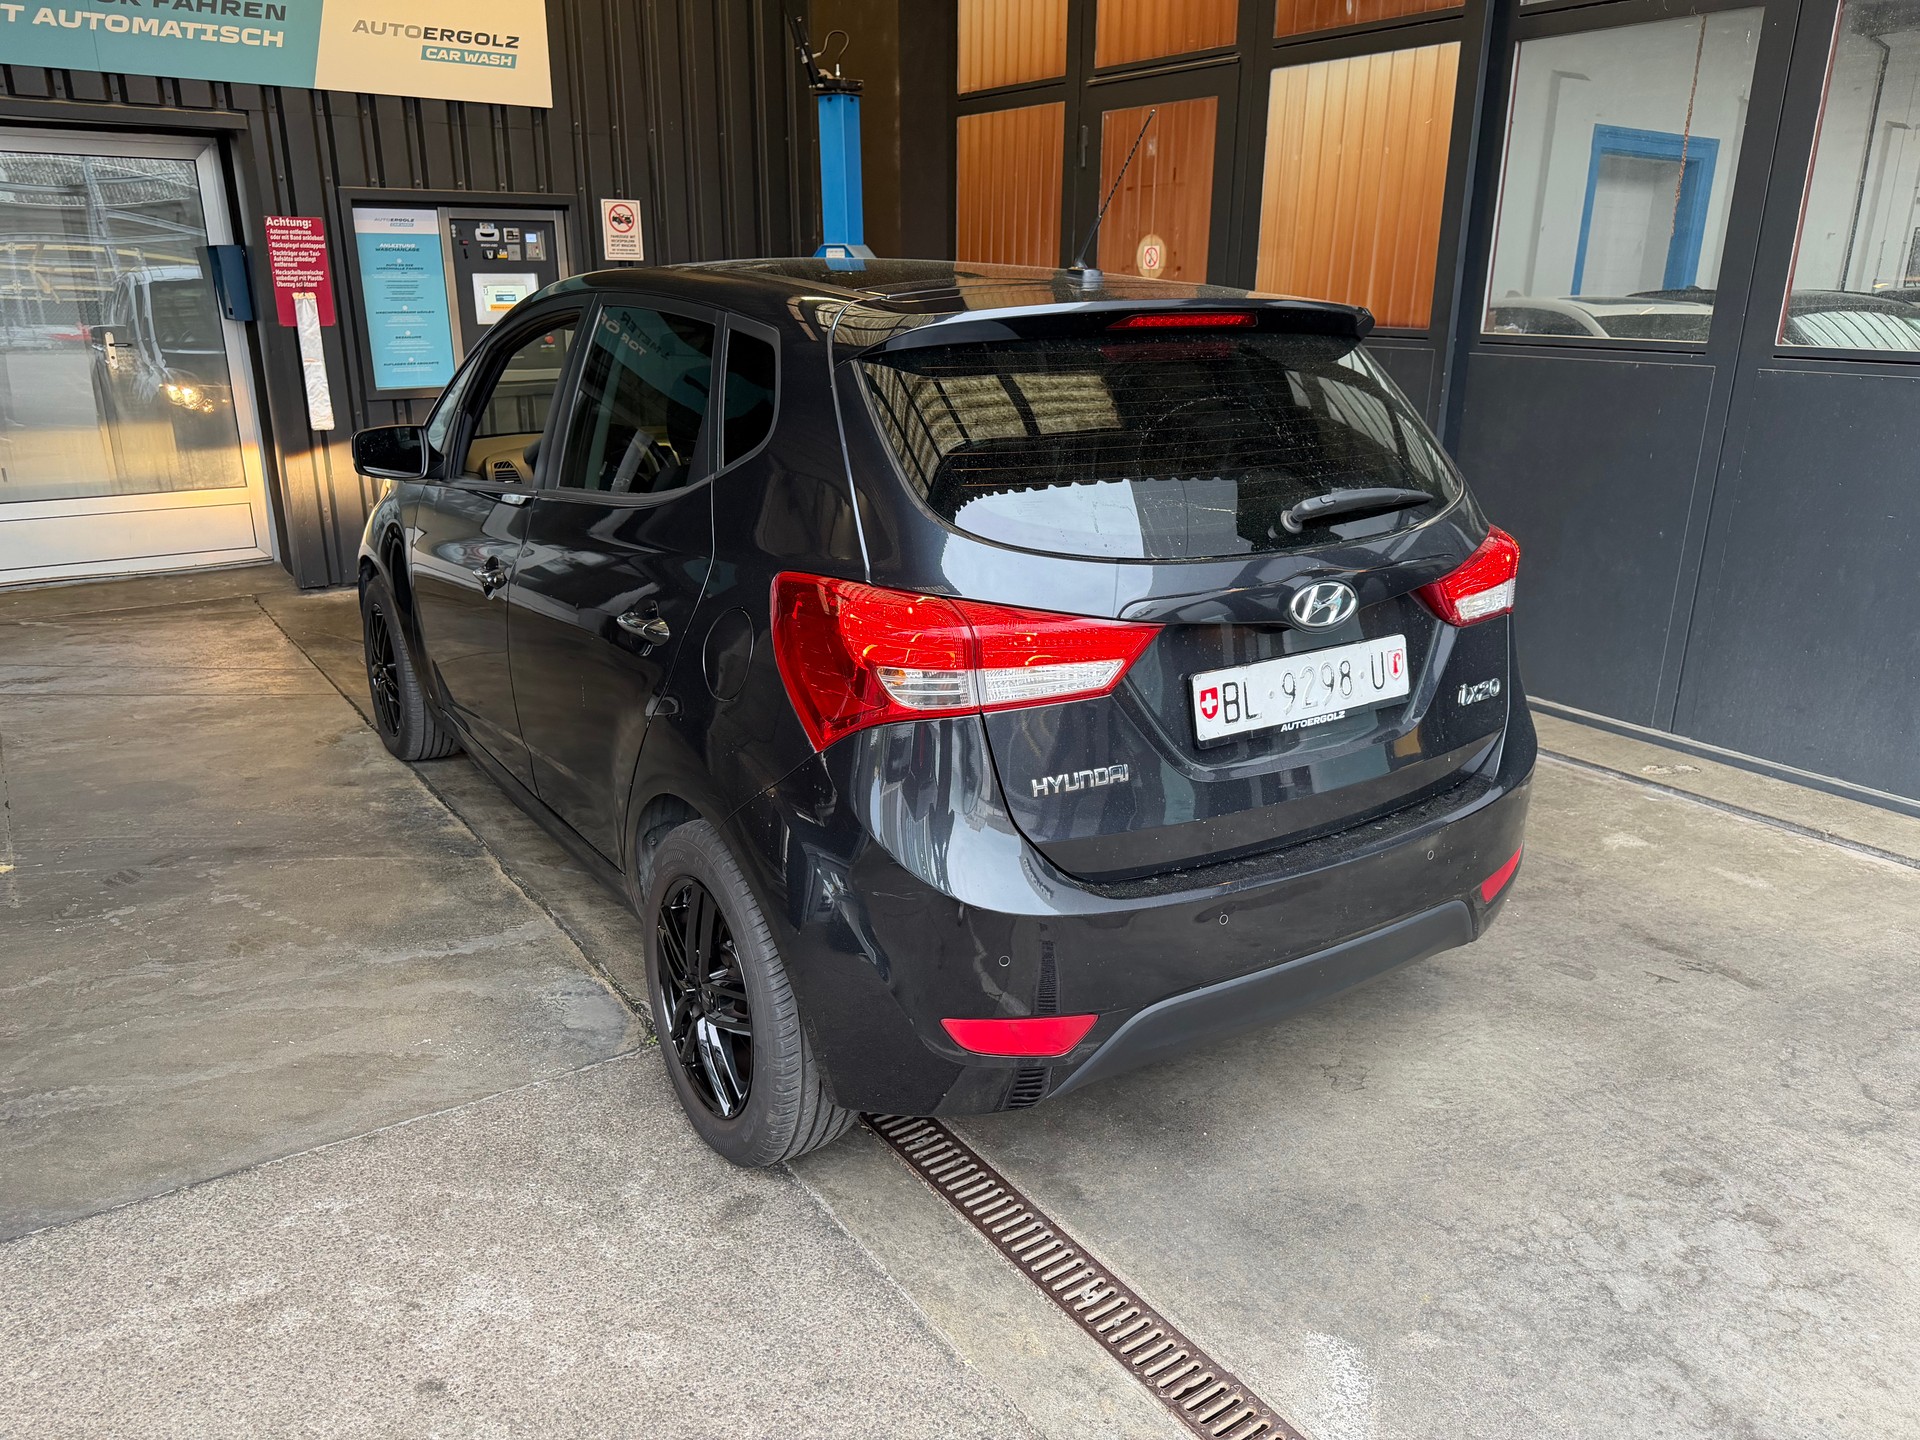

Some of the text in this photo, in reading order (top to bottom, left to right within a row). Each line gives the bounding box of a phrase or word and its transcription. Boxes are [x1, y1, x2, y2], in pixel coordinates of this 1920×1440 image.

[32, 7, 284, 47] AUTOMATISCH
[352, 19, 519, 49] AUTOERGOLZ
[425, 48, 512, 66] CAR WASH
[266, 217, 312, 229] Achtung:
[1222, 651, 1386, 724] BL 9298 U
[1280, 710, 1346, 732] AUTOERGOLZ
[1031, 763, 1129, 798] HYUNDAI
